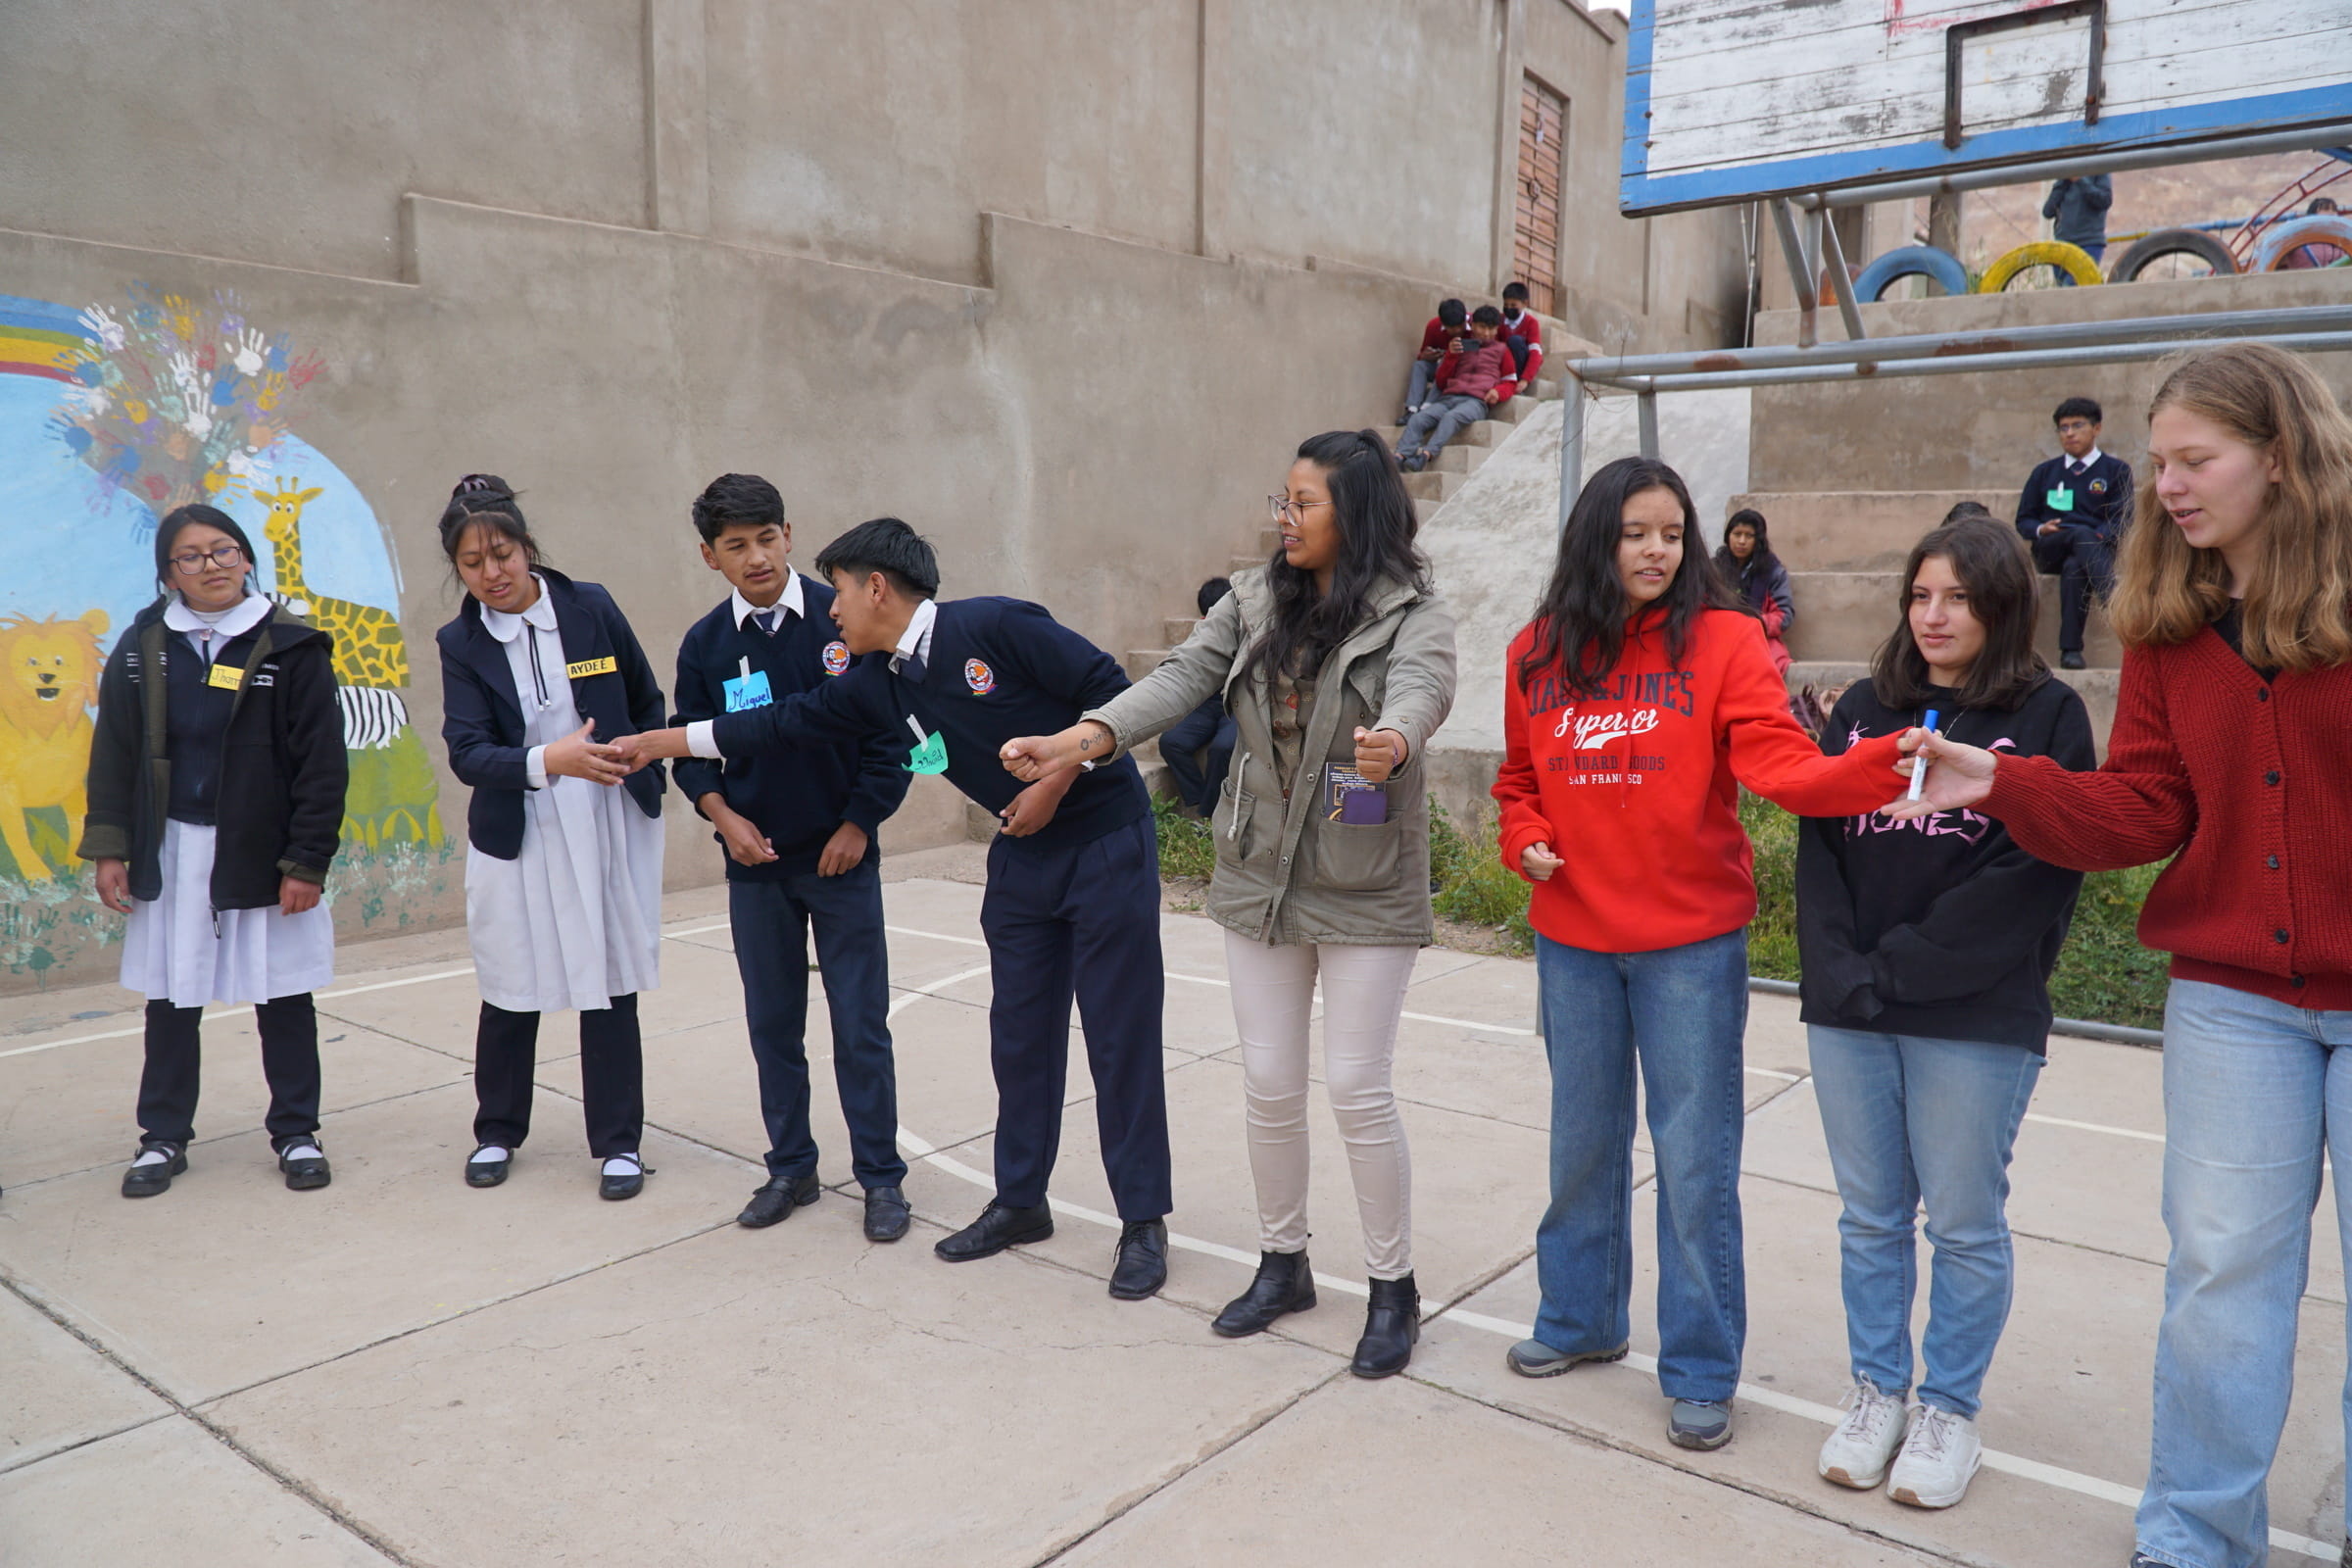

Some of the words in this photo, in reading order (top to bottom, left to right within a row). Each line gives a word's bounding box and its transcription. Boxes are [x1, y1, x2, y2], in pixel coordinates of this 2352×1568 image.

[1629, 755, 1665, 771] OODS
[1568, 774, 1587, 785] SAN
[1591, 772, 1642, 785] FRANSCO
